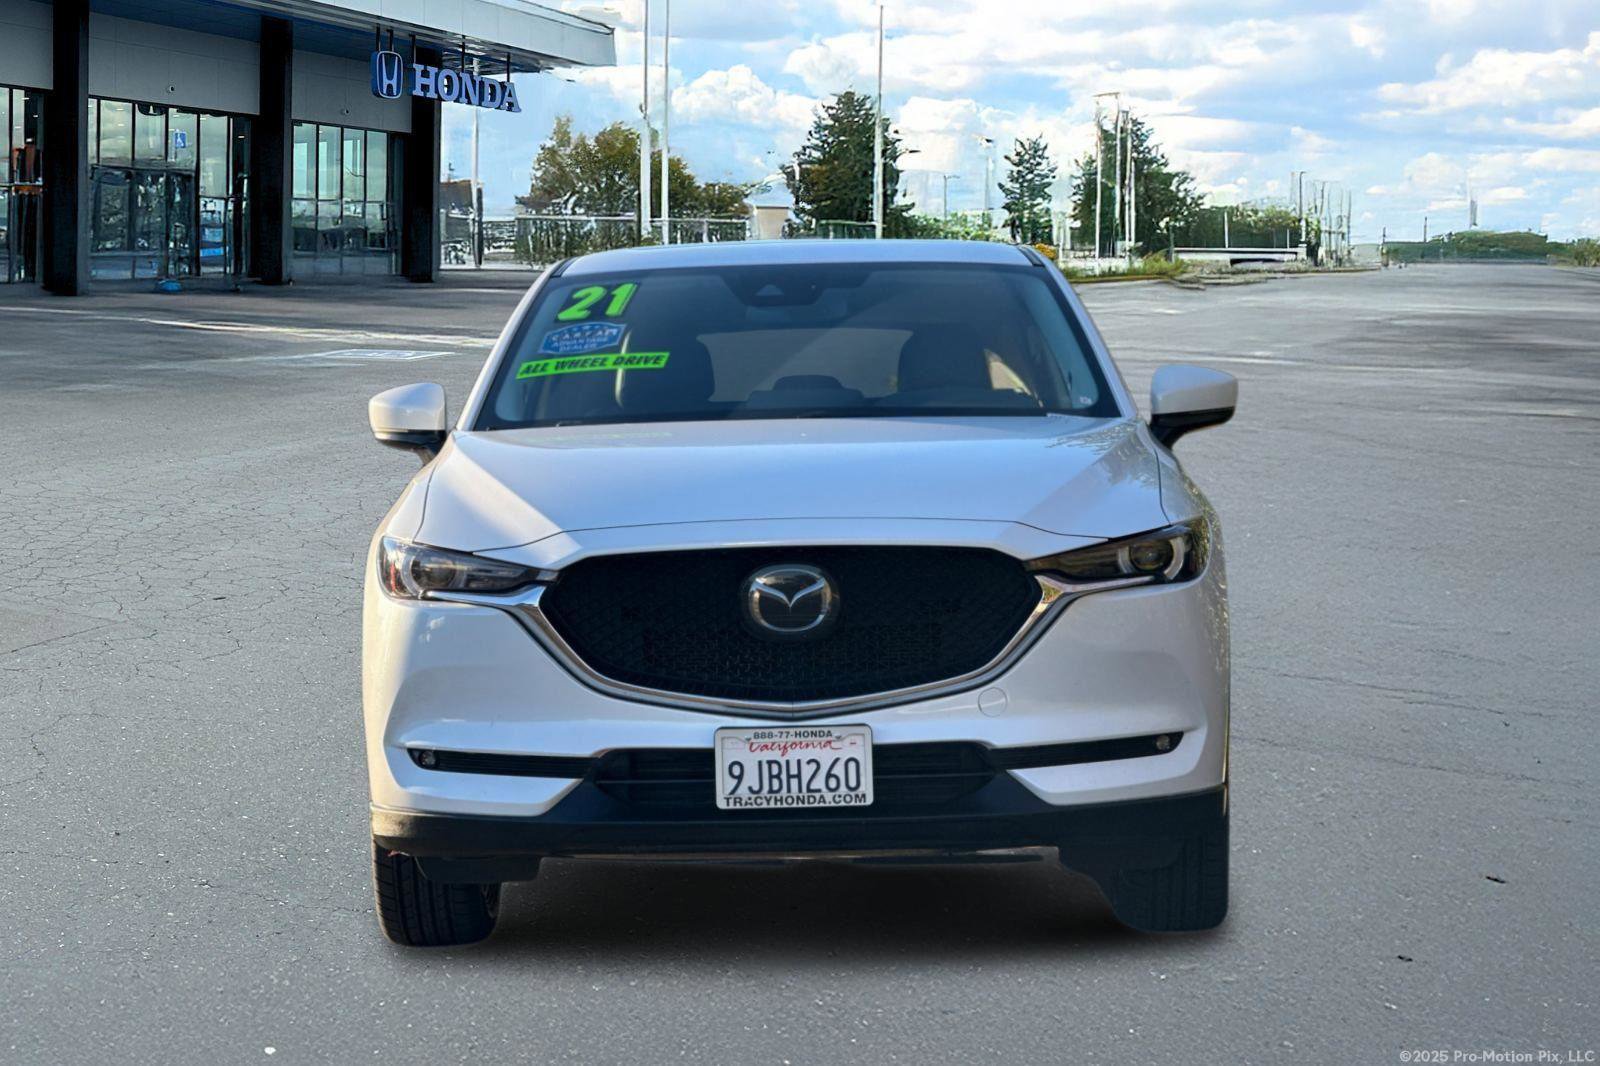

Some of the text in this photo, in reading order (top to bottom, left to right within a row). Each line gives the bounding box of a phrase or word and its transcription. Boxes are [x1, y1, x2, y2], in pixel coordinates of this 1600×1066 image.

[411, 63, 522, 113] HONDA
[557, 282, 639, 321] 21
[519, 353, 665, 376] ALL WHEEL DRIVE
[753, 730, 833, 740] 888-77-HONDA
[749, 740, 843, 757] California
[728, 757, 862, 796] 9JBH260
[724, 793, 867, 807] TRACYHONDA.COM
